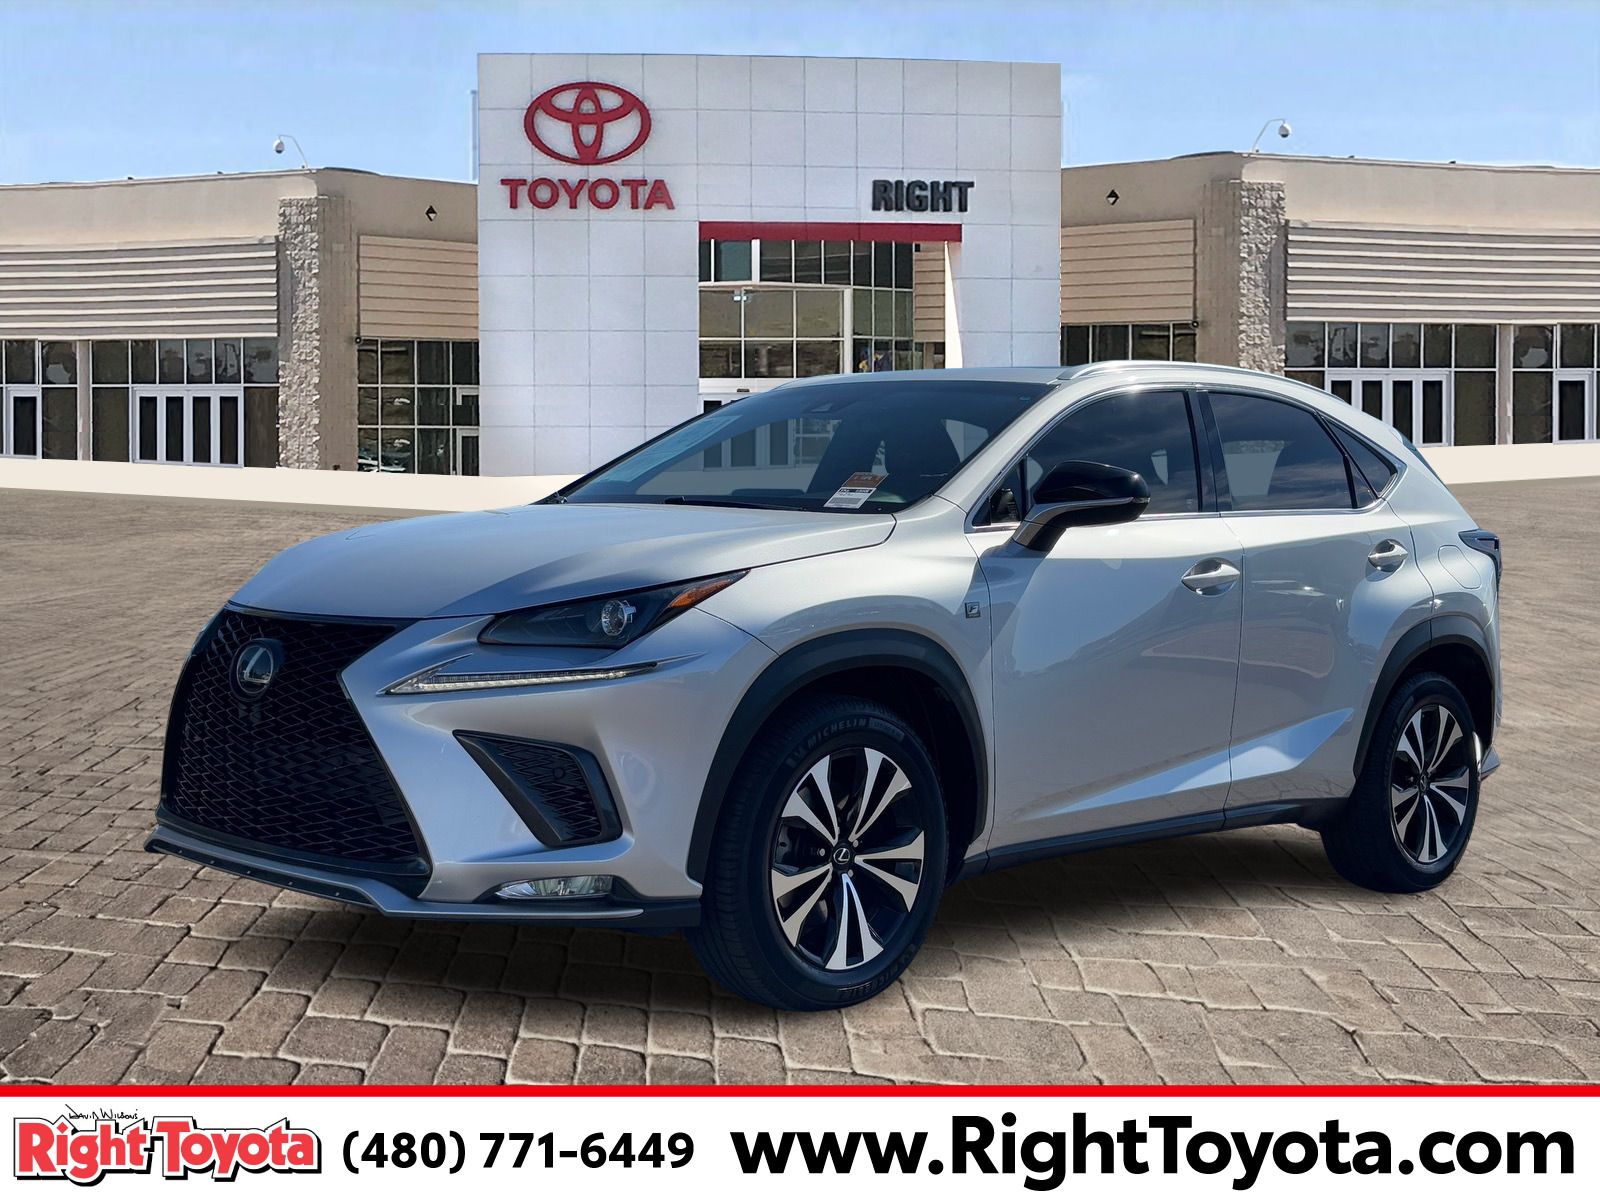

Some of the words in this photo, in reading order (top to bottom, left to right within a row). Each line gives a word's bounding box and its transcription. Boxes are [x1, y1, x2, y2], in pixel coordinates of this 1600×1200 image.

[501, 178, 674, 209] TOYOTA
[872, 180, 975, 213] RIGHT
[807, 717, 867, 750] MICHELIN
